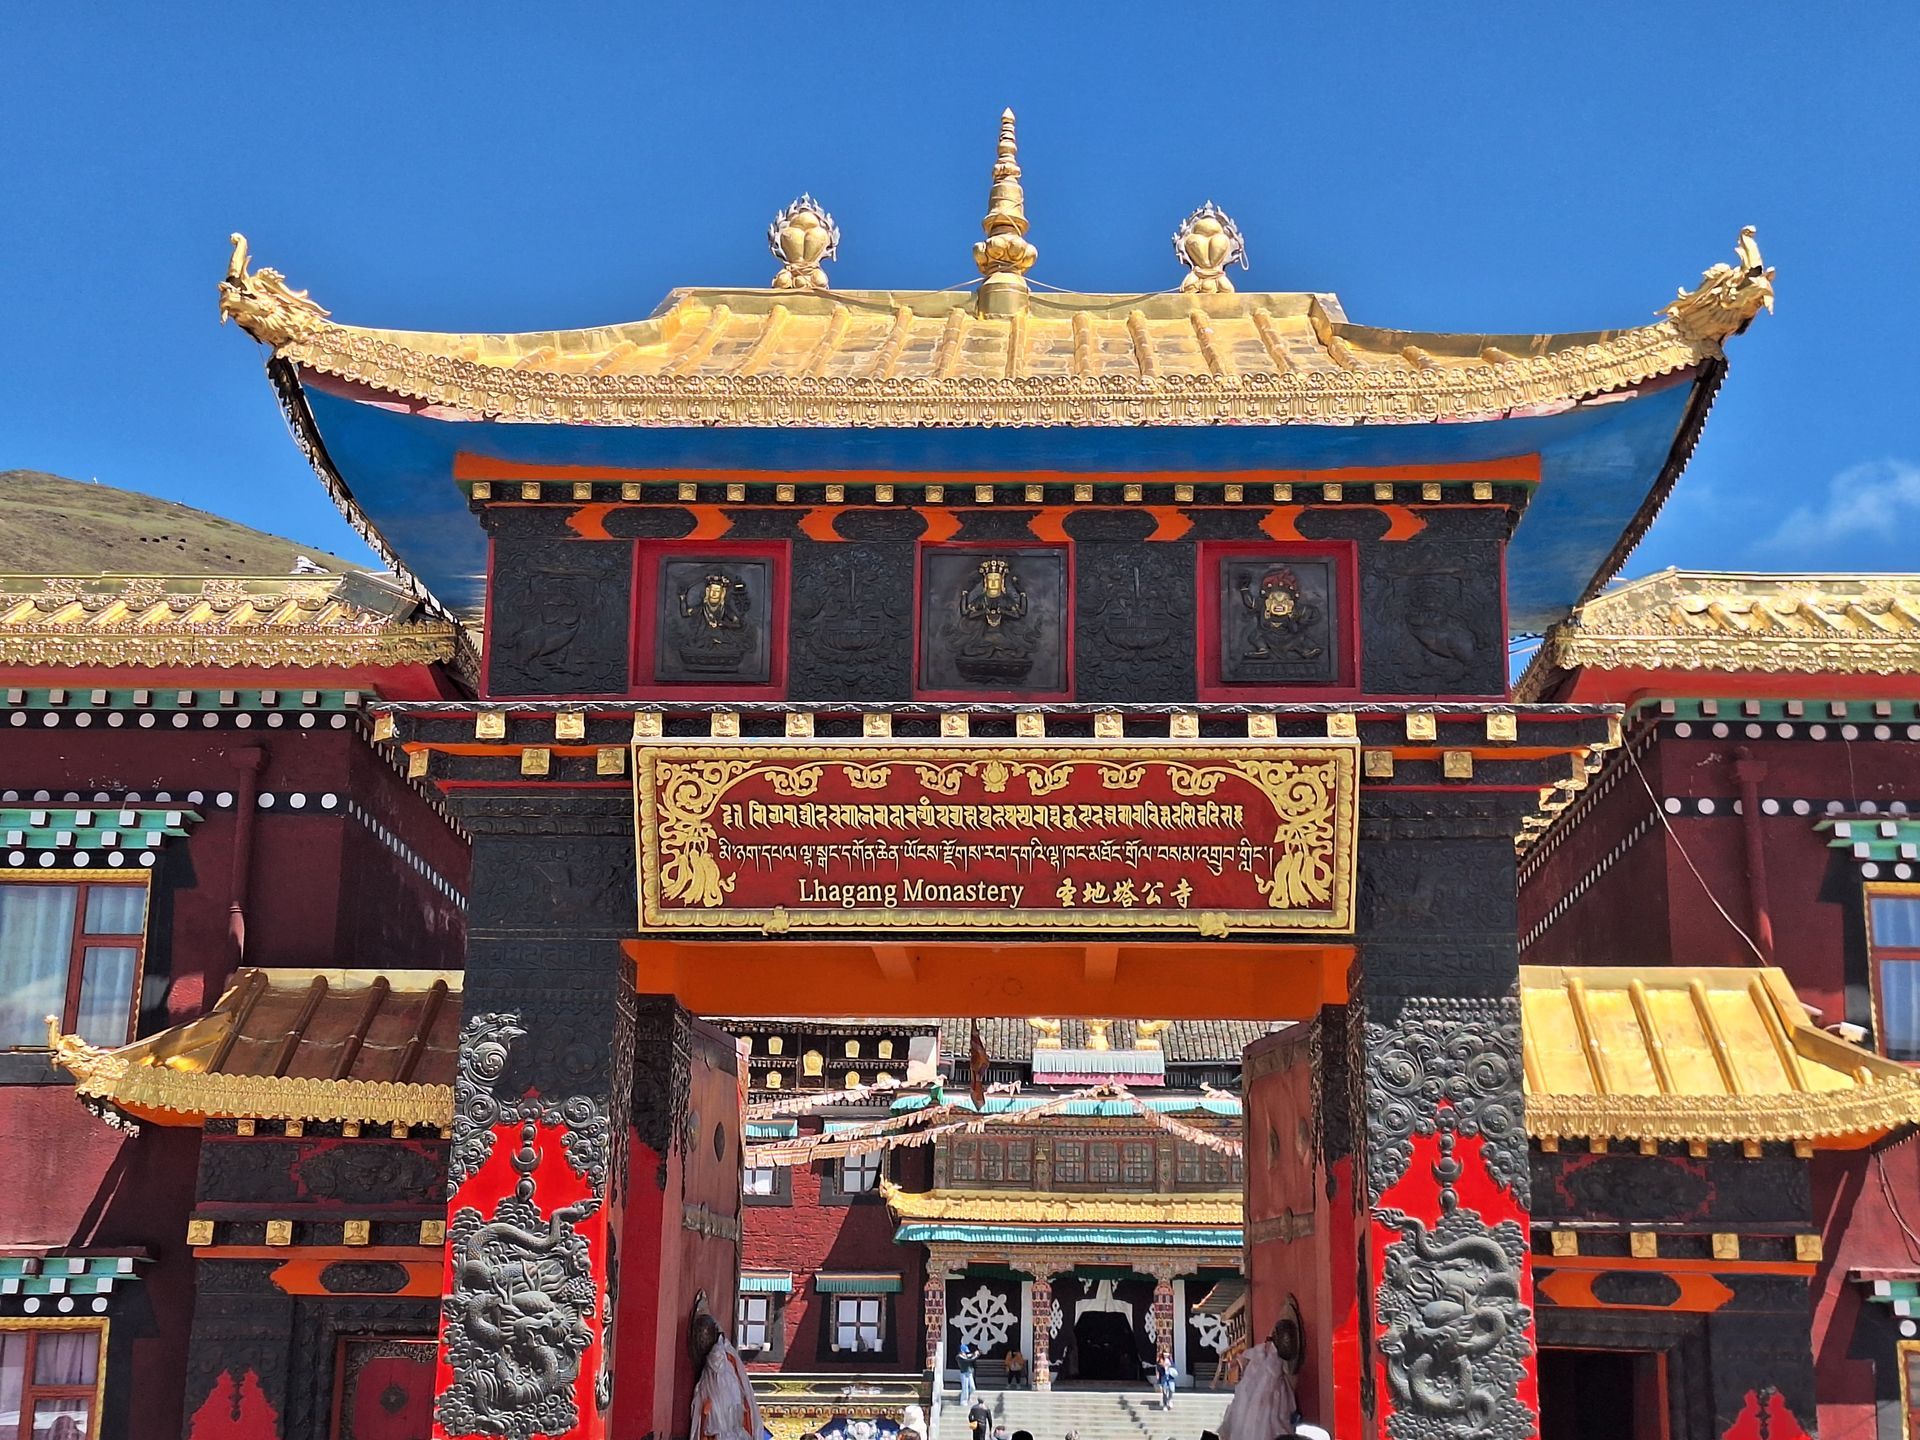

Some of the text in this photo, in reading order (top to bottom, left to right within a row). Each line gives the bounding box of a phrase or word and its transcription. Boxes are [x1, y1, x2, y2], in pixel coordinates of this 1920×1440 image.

[798, 878, 1025, 909] Lhagang Monastery
[1055, 876, 1194, 909] 圣地塔公寺
